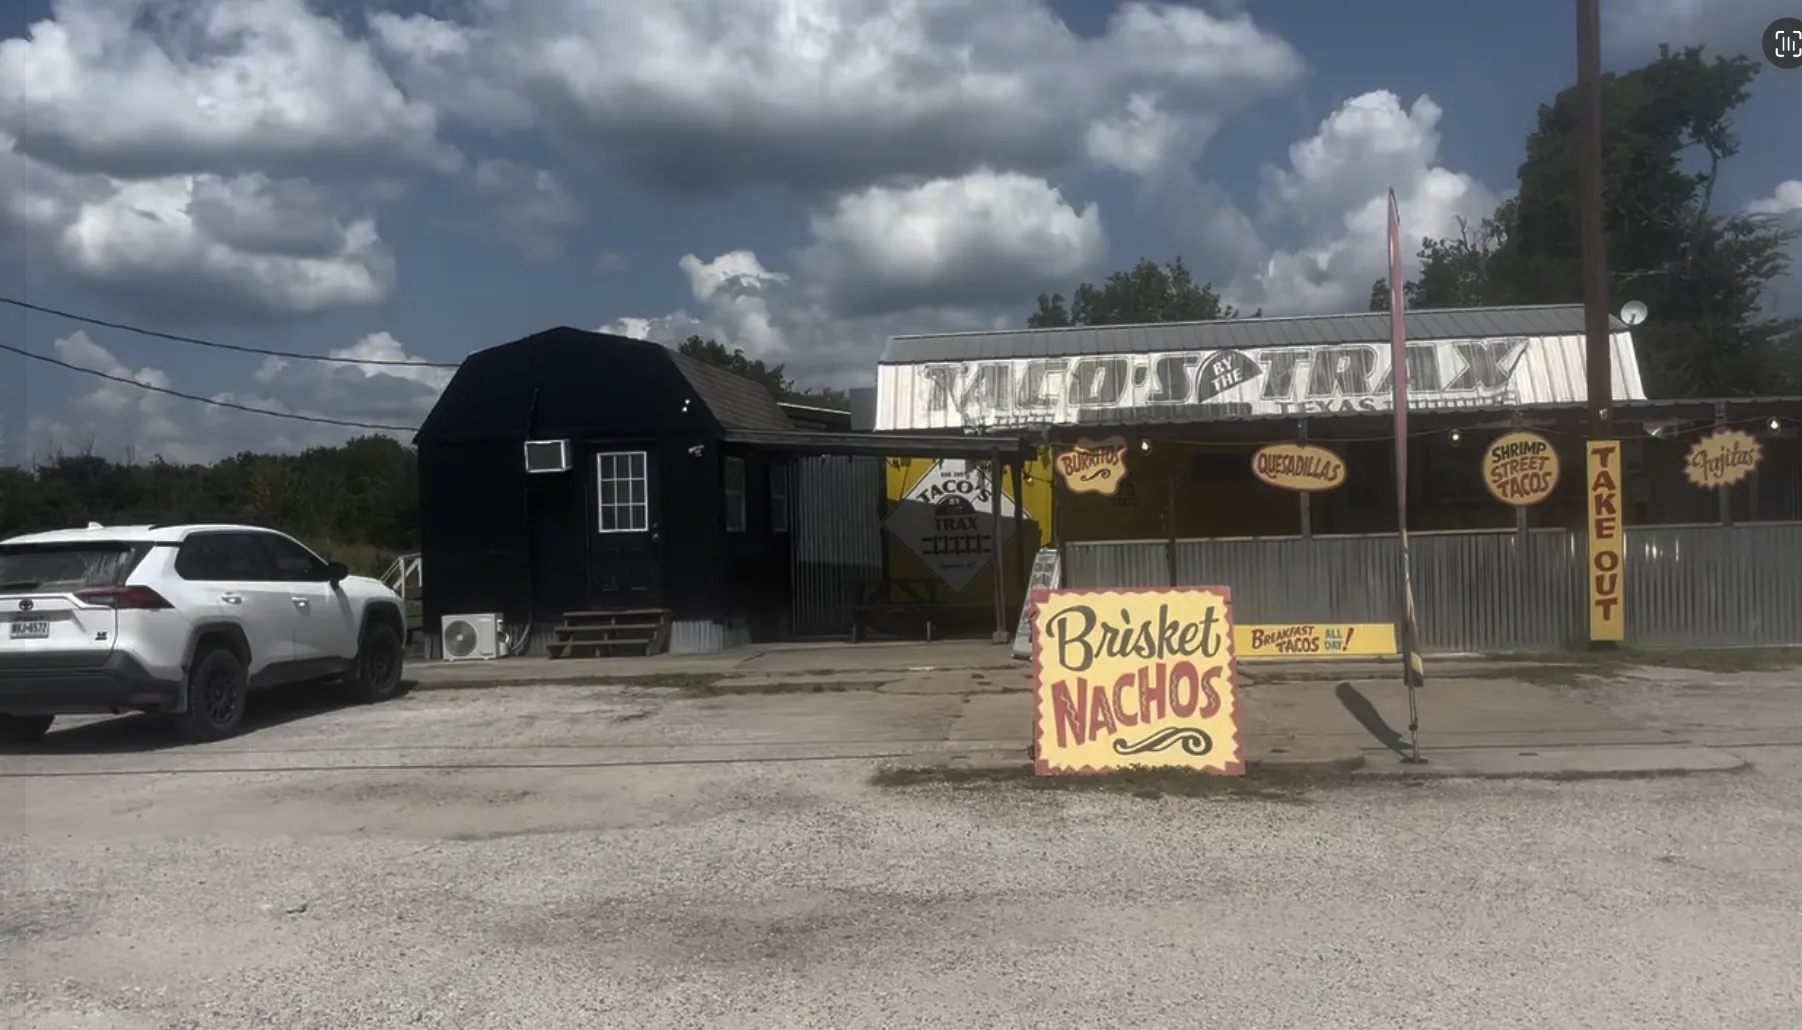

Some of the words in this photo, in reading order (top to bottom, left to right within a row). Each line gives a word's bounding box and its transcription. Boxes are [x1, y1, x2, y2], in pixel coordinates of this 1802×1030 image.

[1213, 356, 1232, 375] BY
[1258, 337, 1530, 400] TRAX
[1210, 368, 1243, 391] THE
[1061, 444, 1124, 476] BURRITOS
[1492, 441, 1547, 463] SHRIMP
[1692, 441, 1755, 481] Fajitas
[1258, 452, 1341, 482] QUESADILLAS
[1490, 456, 1550, 484] STREET
[916, 479, 992, 504] TACO'S
[1496, 472, 1552, 499] TACOS
[1591, 446, 1617, 540] TAKE
[934, 516, 978, 531] TRAX
[1594, 551, 1619, 622] OUT
[1046, 603, 1221, 672] Brisket
[1251, 626, 1314, 649] BREAKFAST
[1276, 637, 1320, 653] TACOS
[1325, 628, 1342, 639] ALL
[1051, 660, 1223, 748] NACHOS
